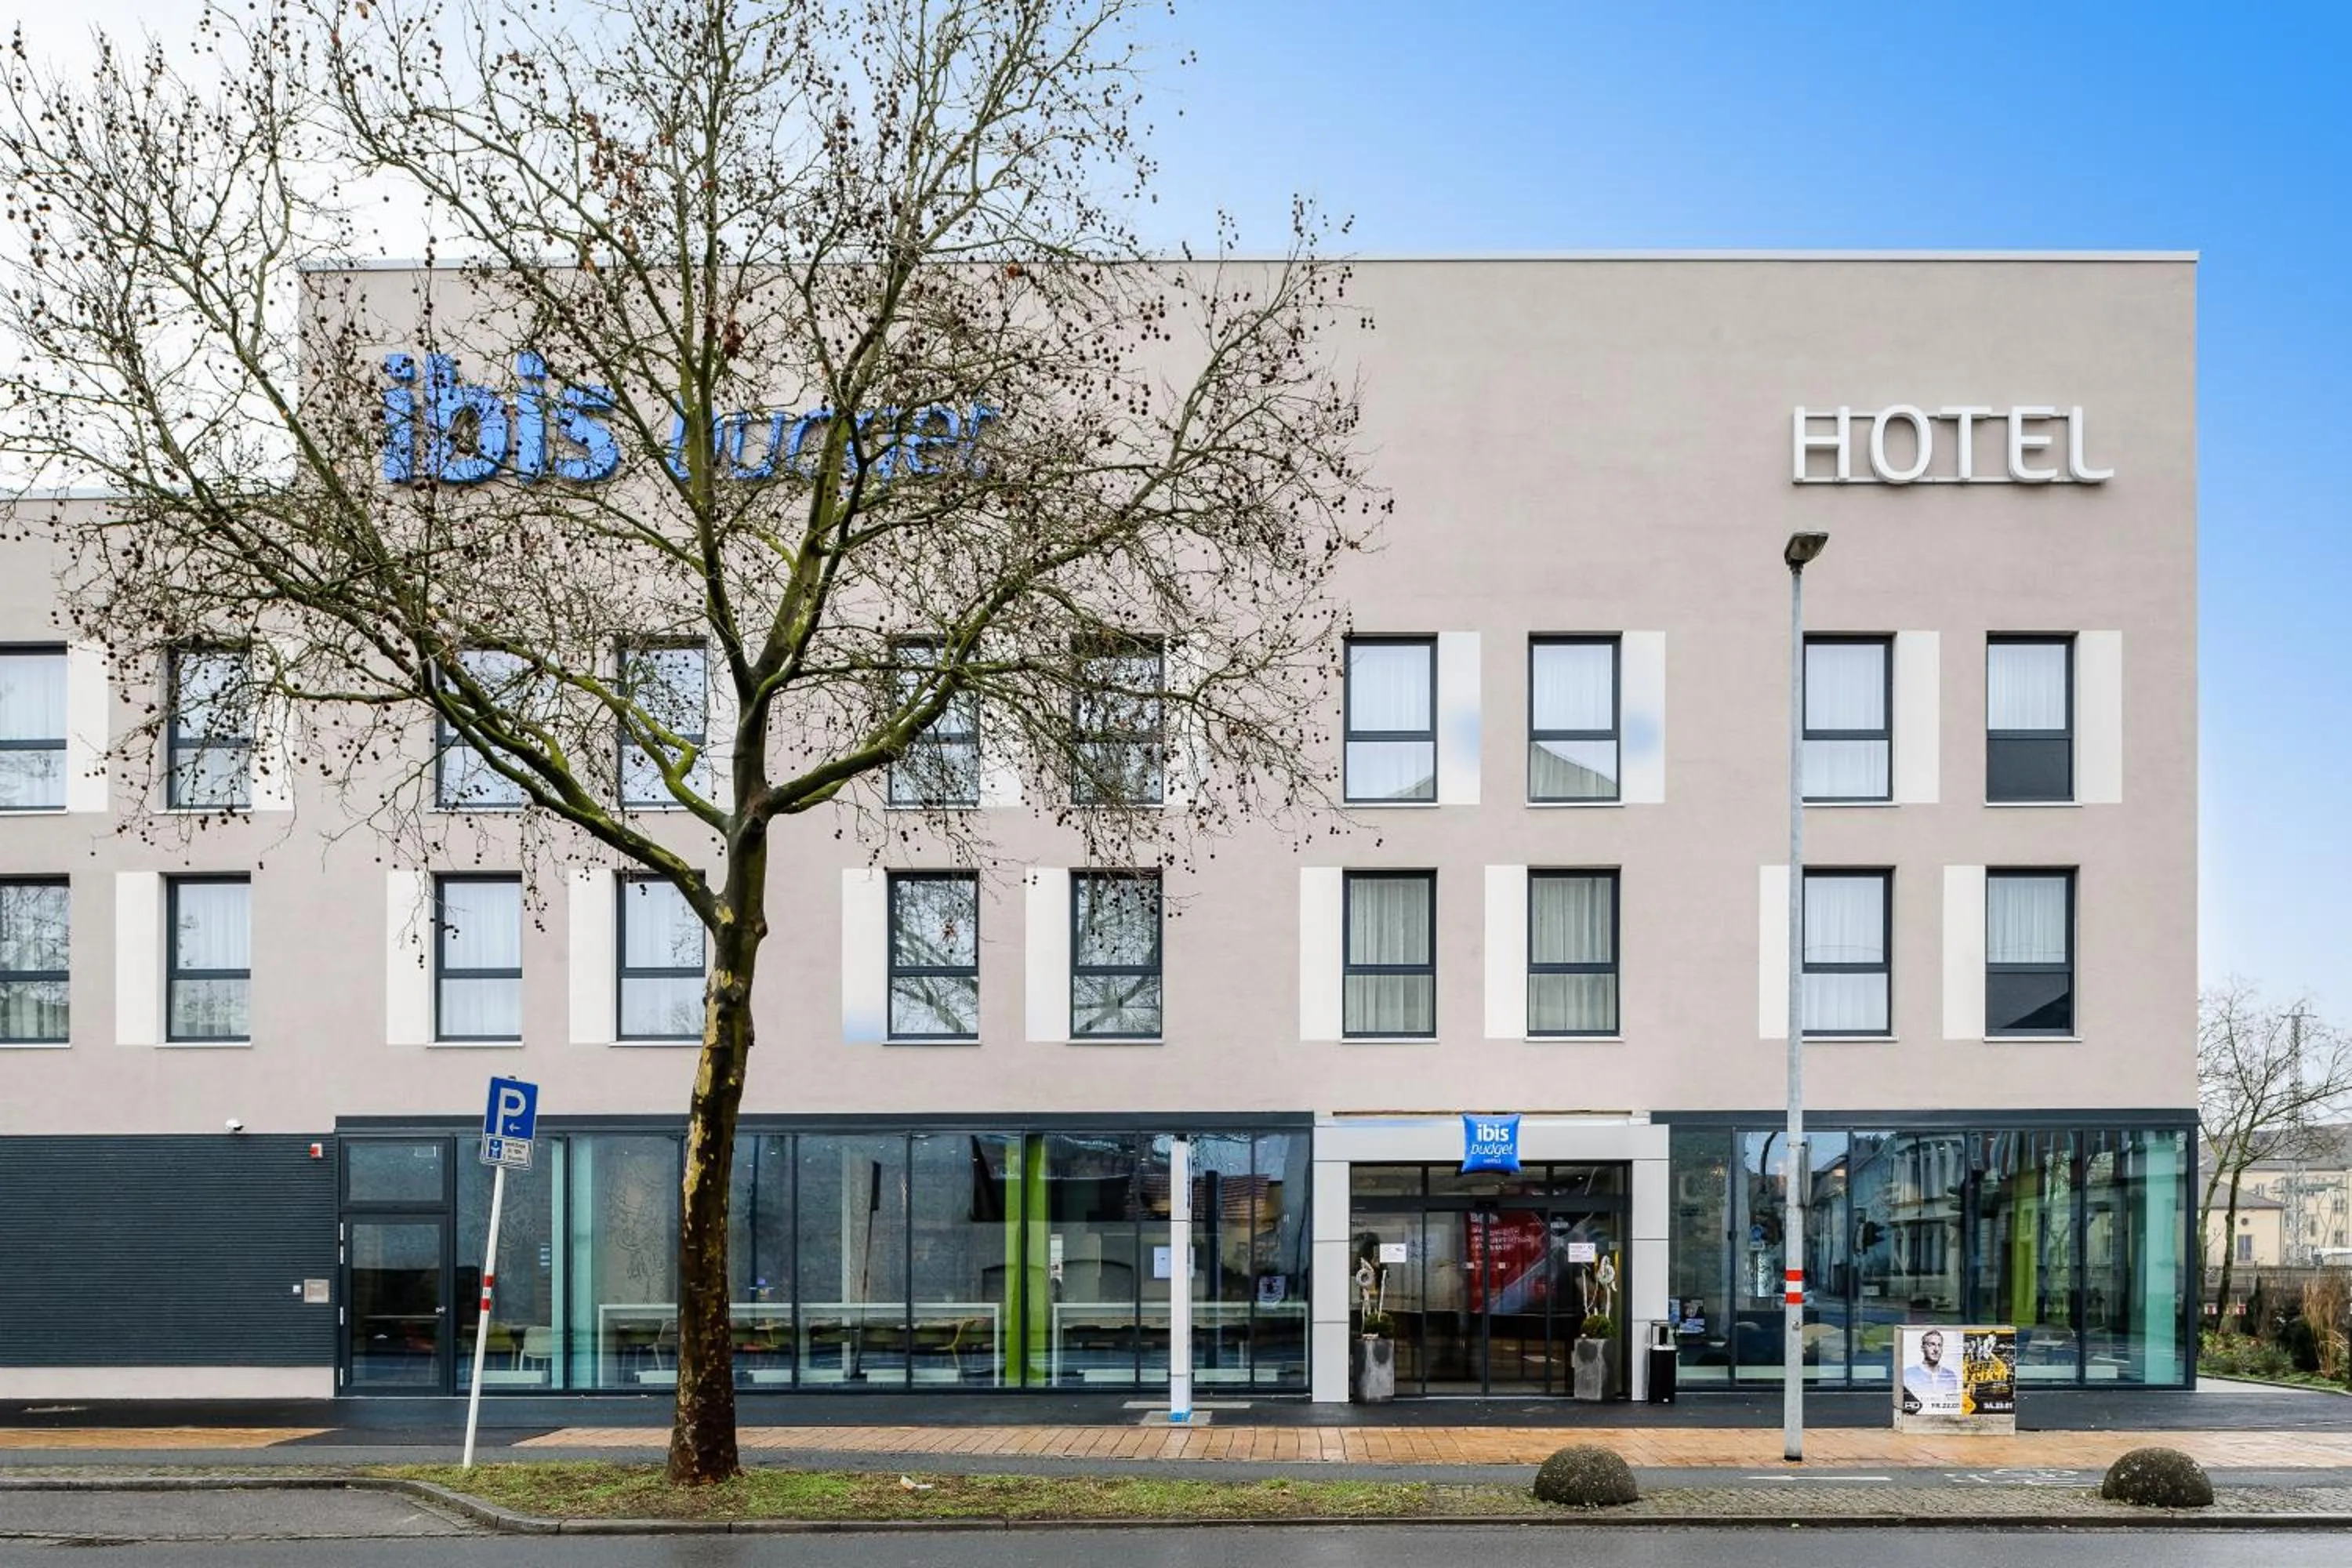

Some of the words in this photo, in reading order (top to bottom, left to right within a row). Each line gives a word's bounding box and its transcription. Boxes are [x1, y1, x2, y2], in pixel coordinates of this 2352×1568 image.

[383, 352, 621, 482] ibis
[1792, 405, 2114, 484] HOTEL
[495, 1087, 526, 1138] P
[1476, 1123, 1509, 1142] ibis
[1470, 1142, 1513, 1158] budget
